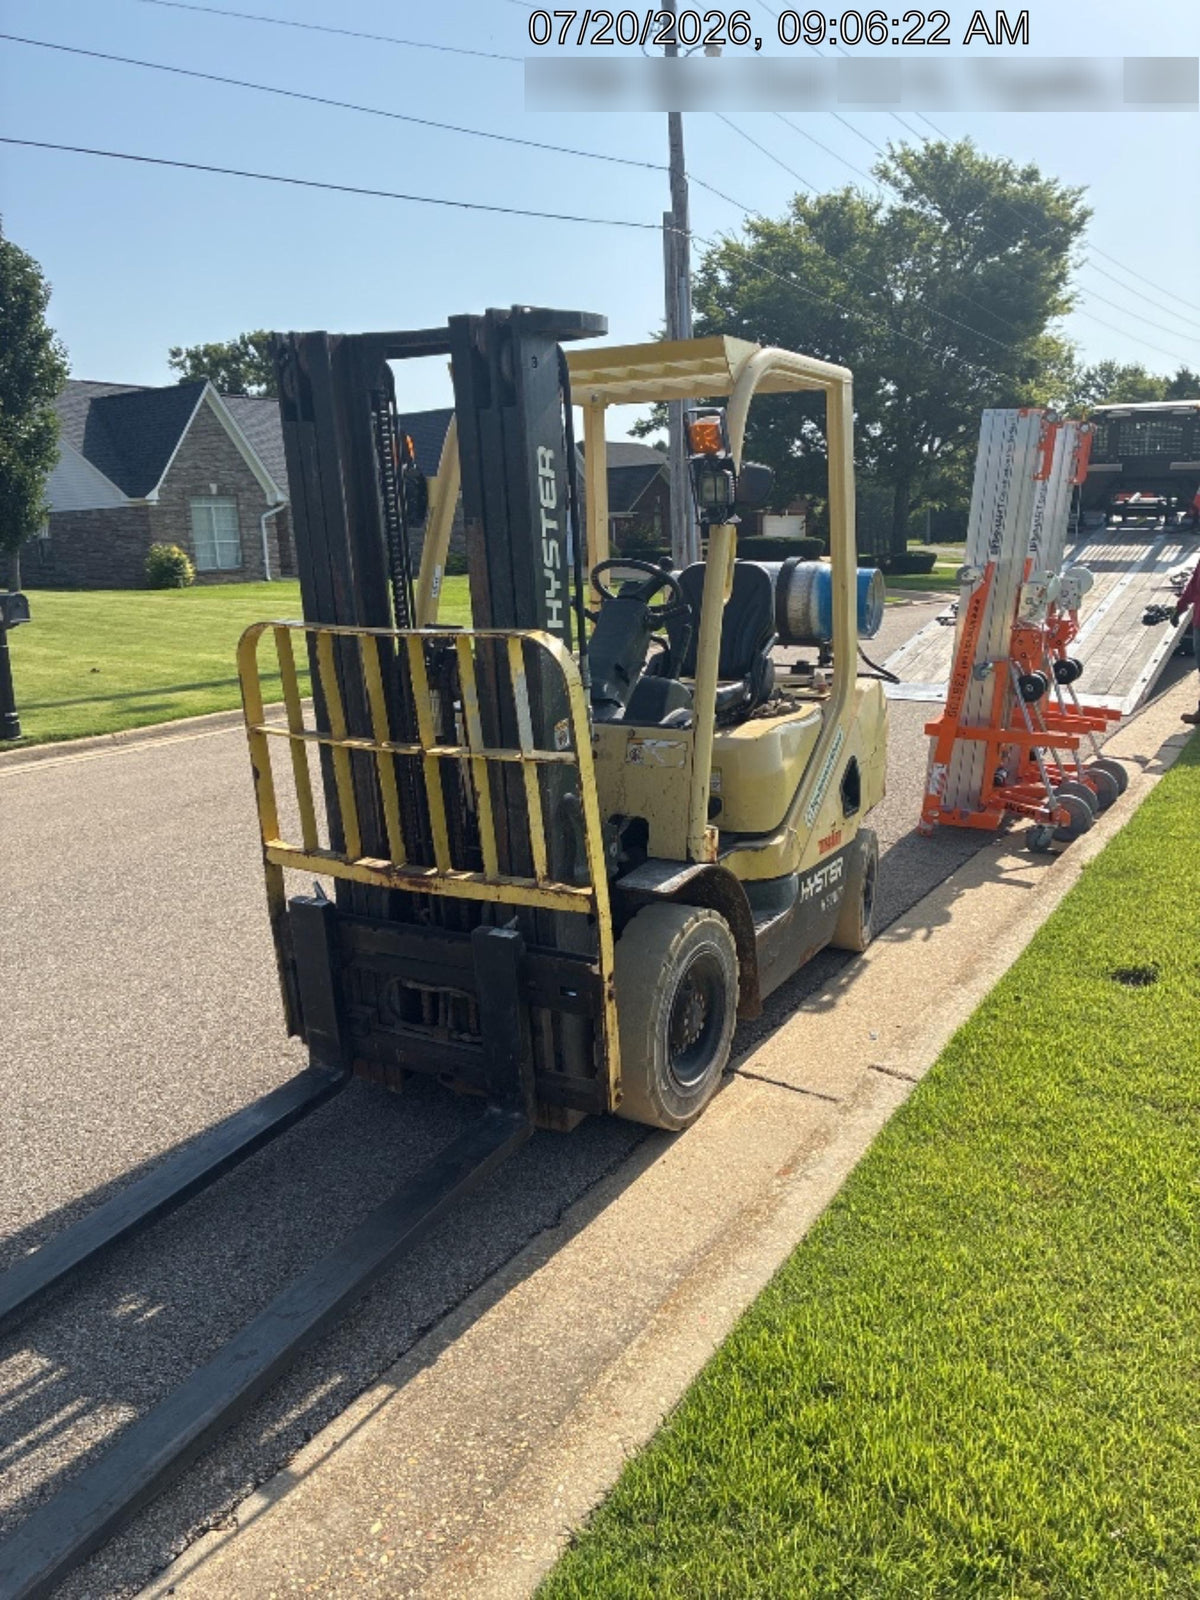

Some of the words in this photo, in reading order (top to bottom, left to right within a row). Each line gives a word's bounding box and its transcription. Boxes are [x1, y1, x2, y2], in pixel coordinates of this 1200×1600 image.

[531, 356, 538, 368] 3
[536, 445, 564, 629] HYSTER
[799, 856, 844, 903] HYSTER
